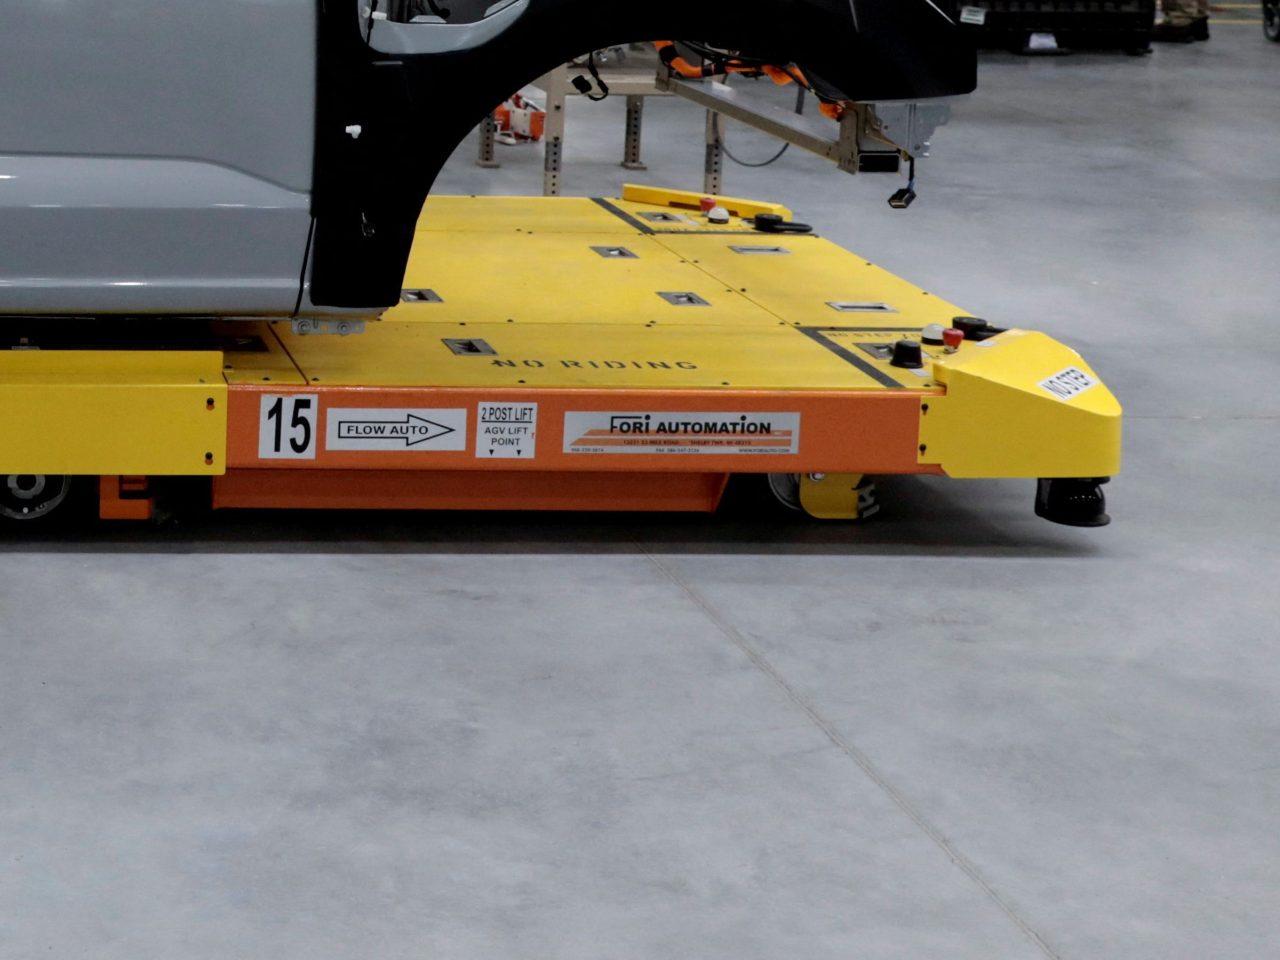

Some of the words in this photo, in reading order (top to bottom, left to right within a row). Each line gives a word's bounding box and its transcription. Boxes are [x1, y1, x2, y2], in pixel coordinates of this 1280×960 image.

[491, 358, 545, 368] NO
[560, 360, 698, 370] RIDING
[481, 407, 487, 420] 2
[488, 407, 512, 420] POST
[515, 408, 534, 421] LIFT
[267, 397, 311, 454] 15
[347, 424, 385, 436] FLOW
[389, 425, 429, 436] AUTO
[484, 426, 505, 435] AGV
[507, 426, 529, 435] LIFT
[491, 437, 521, 446] POINT
